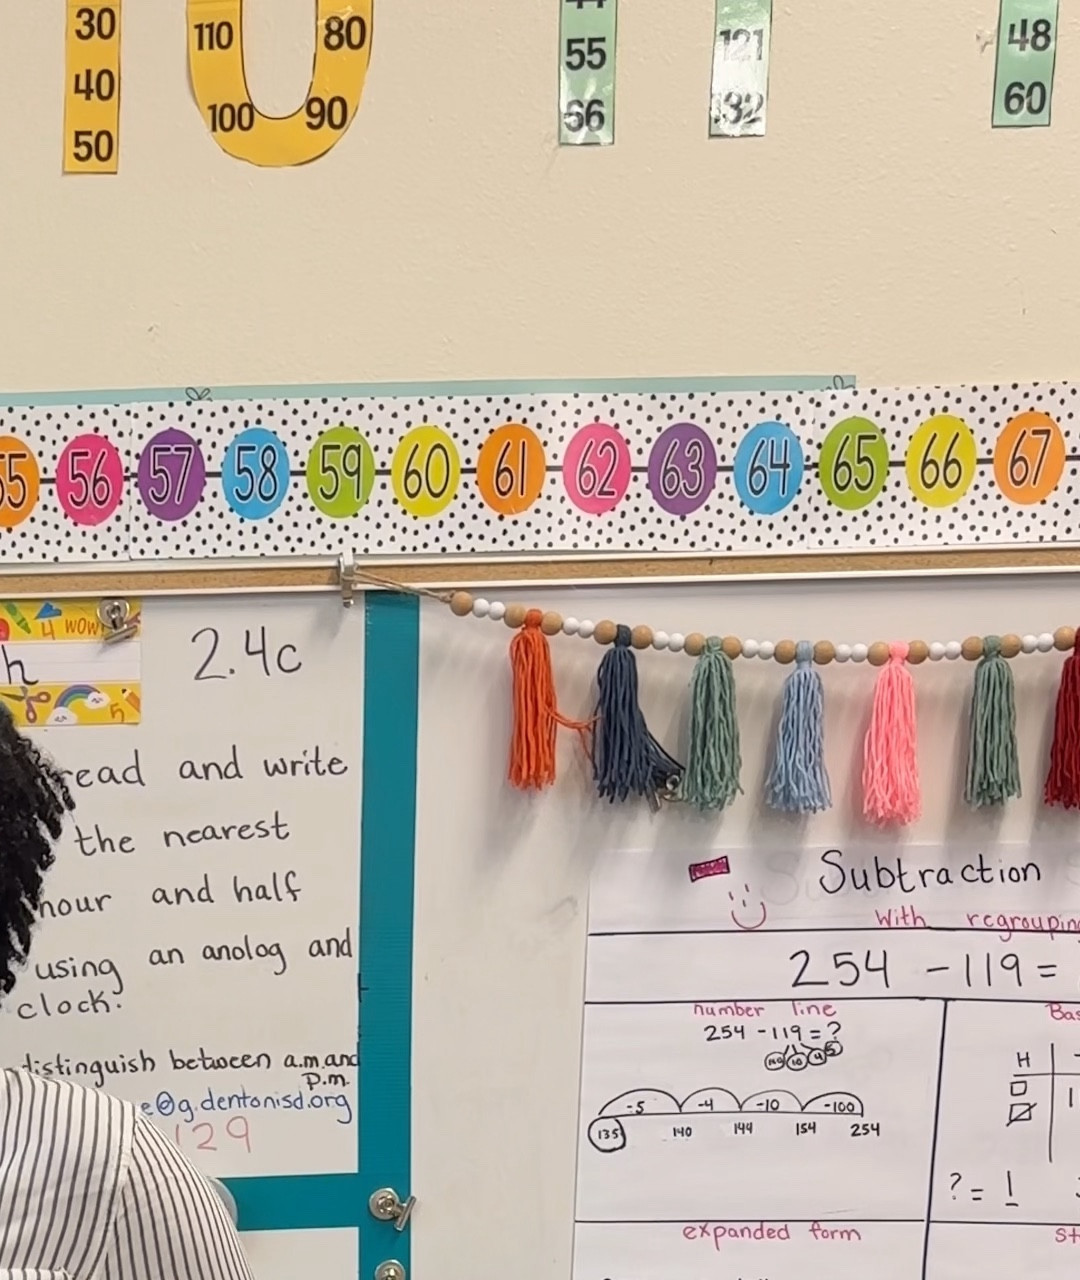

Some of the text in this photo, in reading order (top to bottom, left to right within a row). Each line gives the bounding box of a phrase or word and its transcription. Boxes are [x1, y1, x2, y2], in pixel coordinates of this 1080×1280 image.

[75, 9, 116, 40] 30
[324, 18, 366, 50] 80
[565, 38, 606, 70] 55
[1004, 81, 1046, 115] 60
[207, 104, 255, 132] 100
[72, 131, 113, 162] 50
[151, 446, 194, 503] 57
[403, 444, 450, 498] 60
[579, 441, 617, 496] 62
[833, 435, 878, 490] 65
[1009, 429, 1050, 489] 67
[191, 625, 302, 681] 2.4c
[179, 745, 242, 779] and
[264, 747, 348, 778] write
[75, 811, 289, 855] the nearest
[820, 848, 1041, 894] Subtraction
[152, 874, 214, 904] and
[233, 871, 302, 902] half
[876, 909, 926, 928] With
[35, 957, 124, 994] using
[149, 947, 184, 965] an
[308, 928, 353, 958] and
[790, 950, 889, 987] 254
[694, 1001, 837, 1016] number line
[704, 1025, 745, 1040] 254
[169, 1047, 270, 1070] between
[1017, 1052, 1030, 1067] H
[626, 1099, 855, 1113] -5 -4 -10 -100
[597, 1123, 879, 1140] 135 144 154 254
[682, 1221, 861, 1251] expanded form
